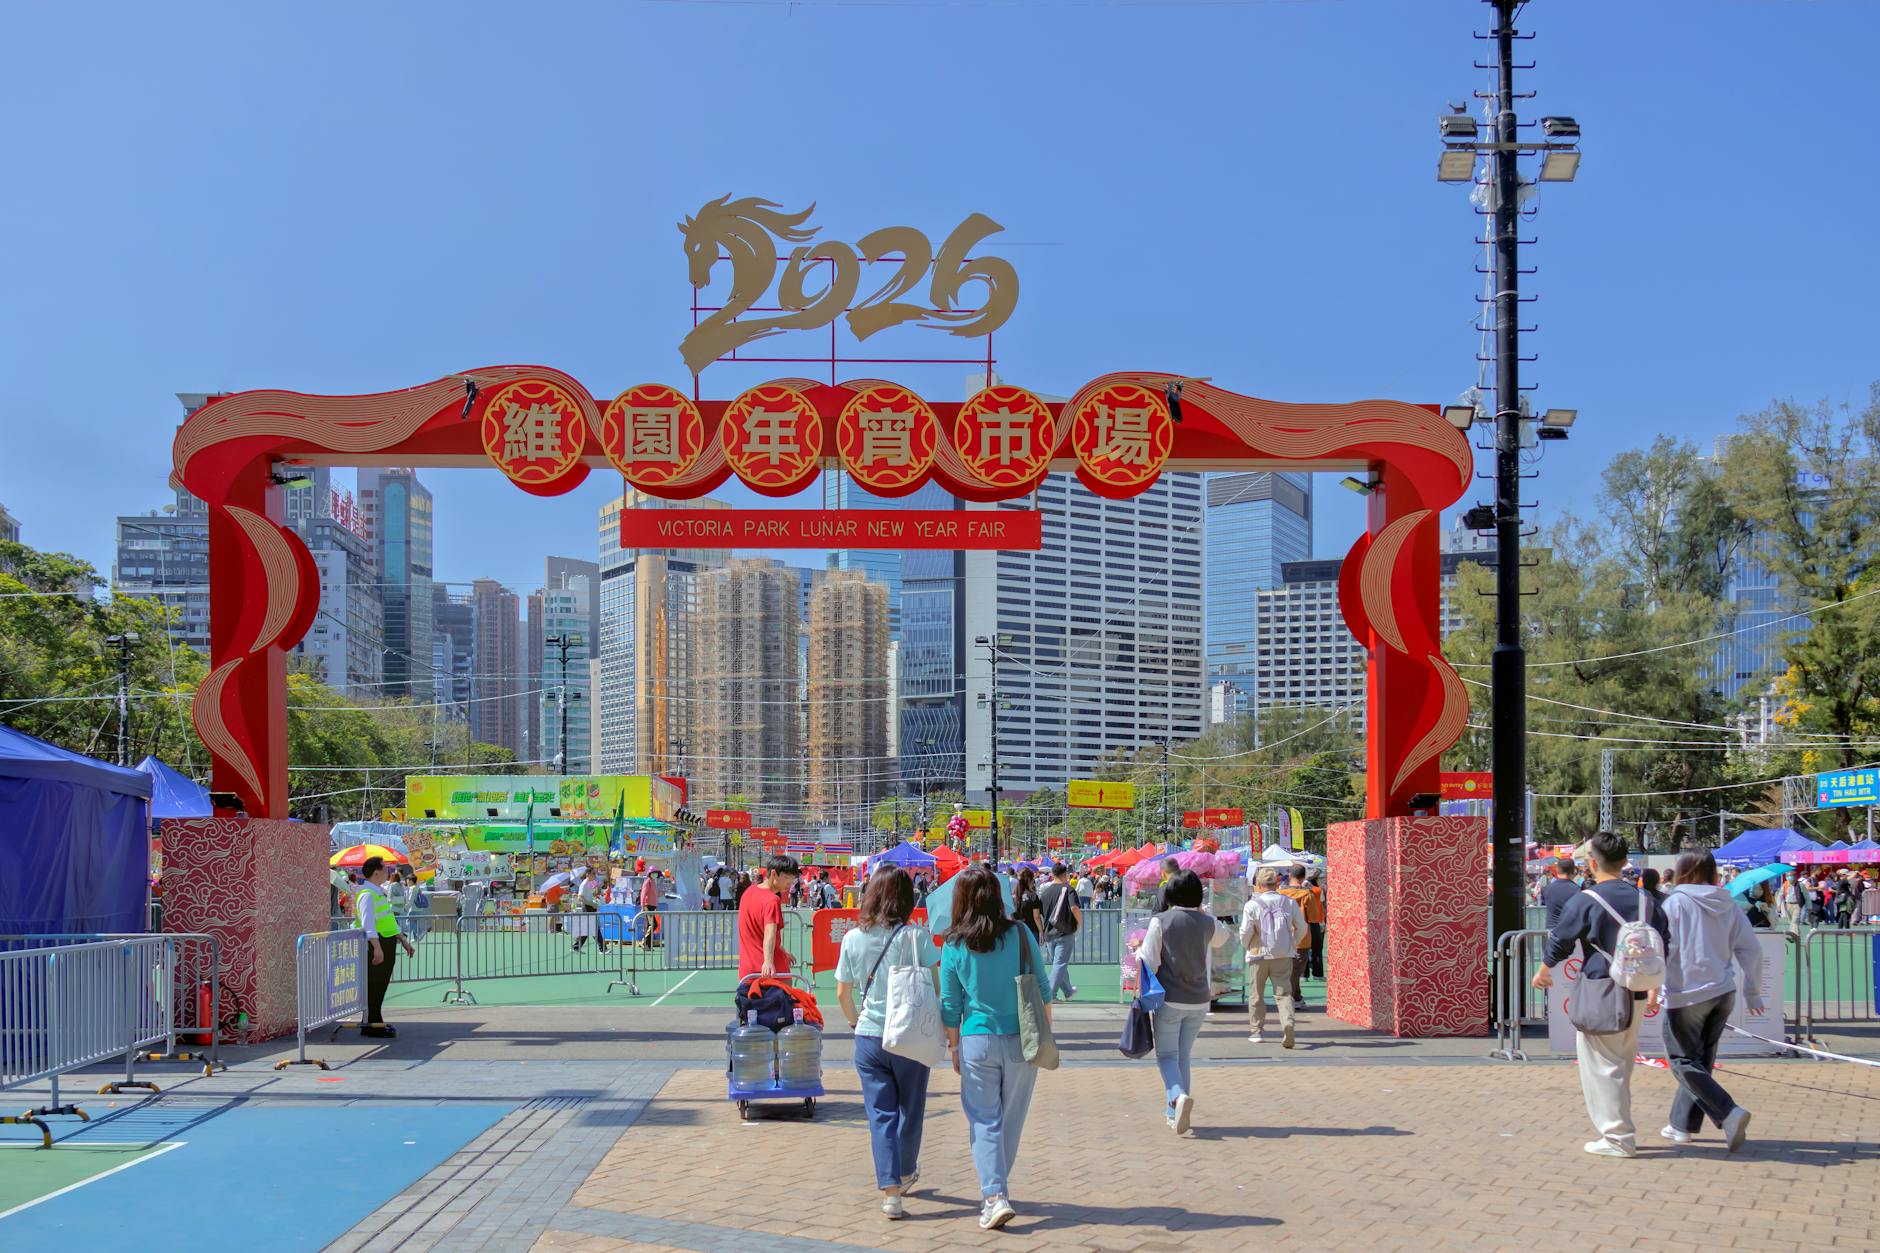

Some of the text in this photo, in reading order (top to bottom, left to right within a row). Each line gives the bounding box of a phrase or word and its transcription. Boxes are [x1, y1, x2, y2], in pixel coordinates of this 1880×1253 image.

[678, 192, 1019, 377] 2026
[503, 402, 1153, 467] 維園年宵市場
[657, 520, 1006, 538] VICTORIA PARK LUNAR NEW YEAR FAIR
